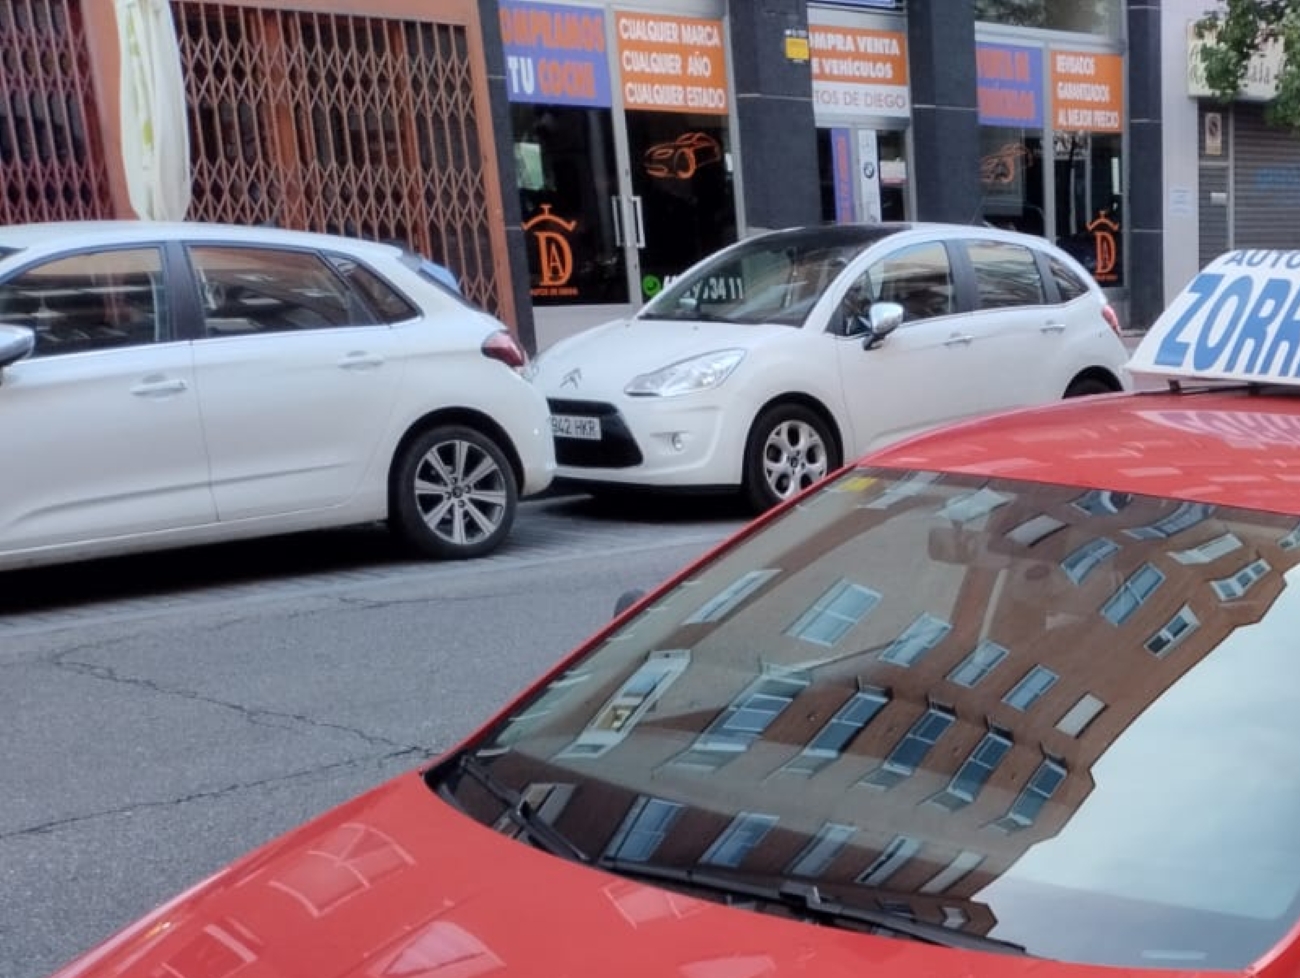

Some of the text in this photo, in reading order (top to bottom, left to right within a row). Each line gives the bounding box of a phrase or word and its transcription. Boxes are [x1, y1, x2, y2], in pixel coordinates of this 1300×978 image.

[619, 18, 721, 48] CUALQUIER MARCA
[508, 56, 535, 95] TU
[623, 51, 682, 75] CUALQUIER
